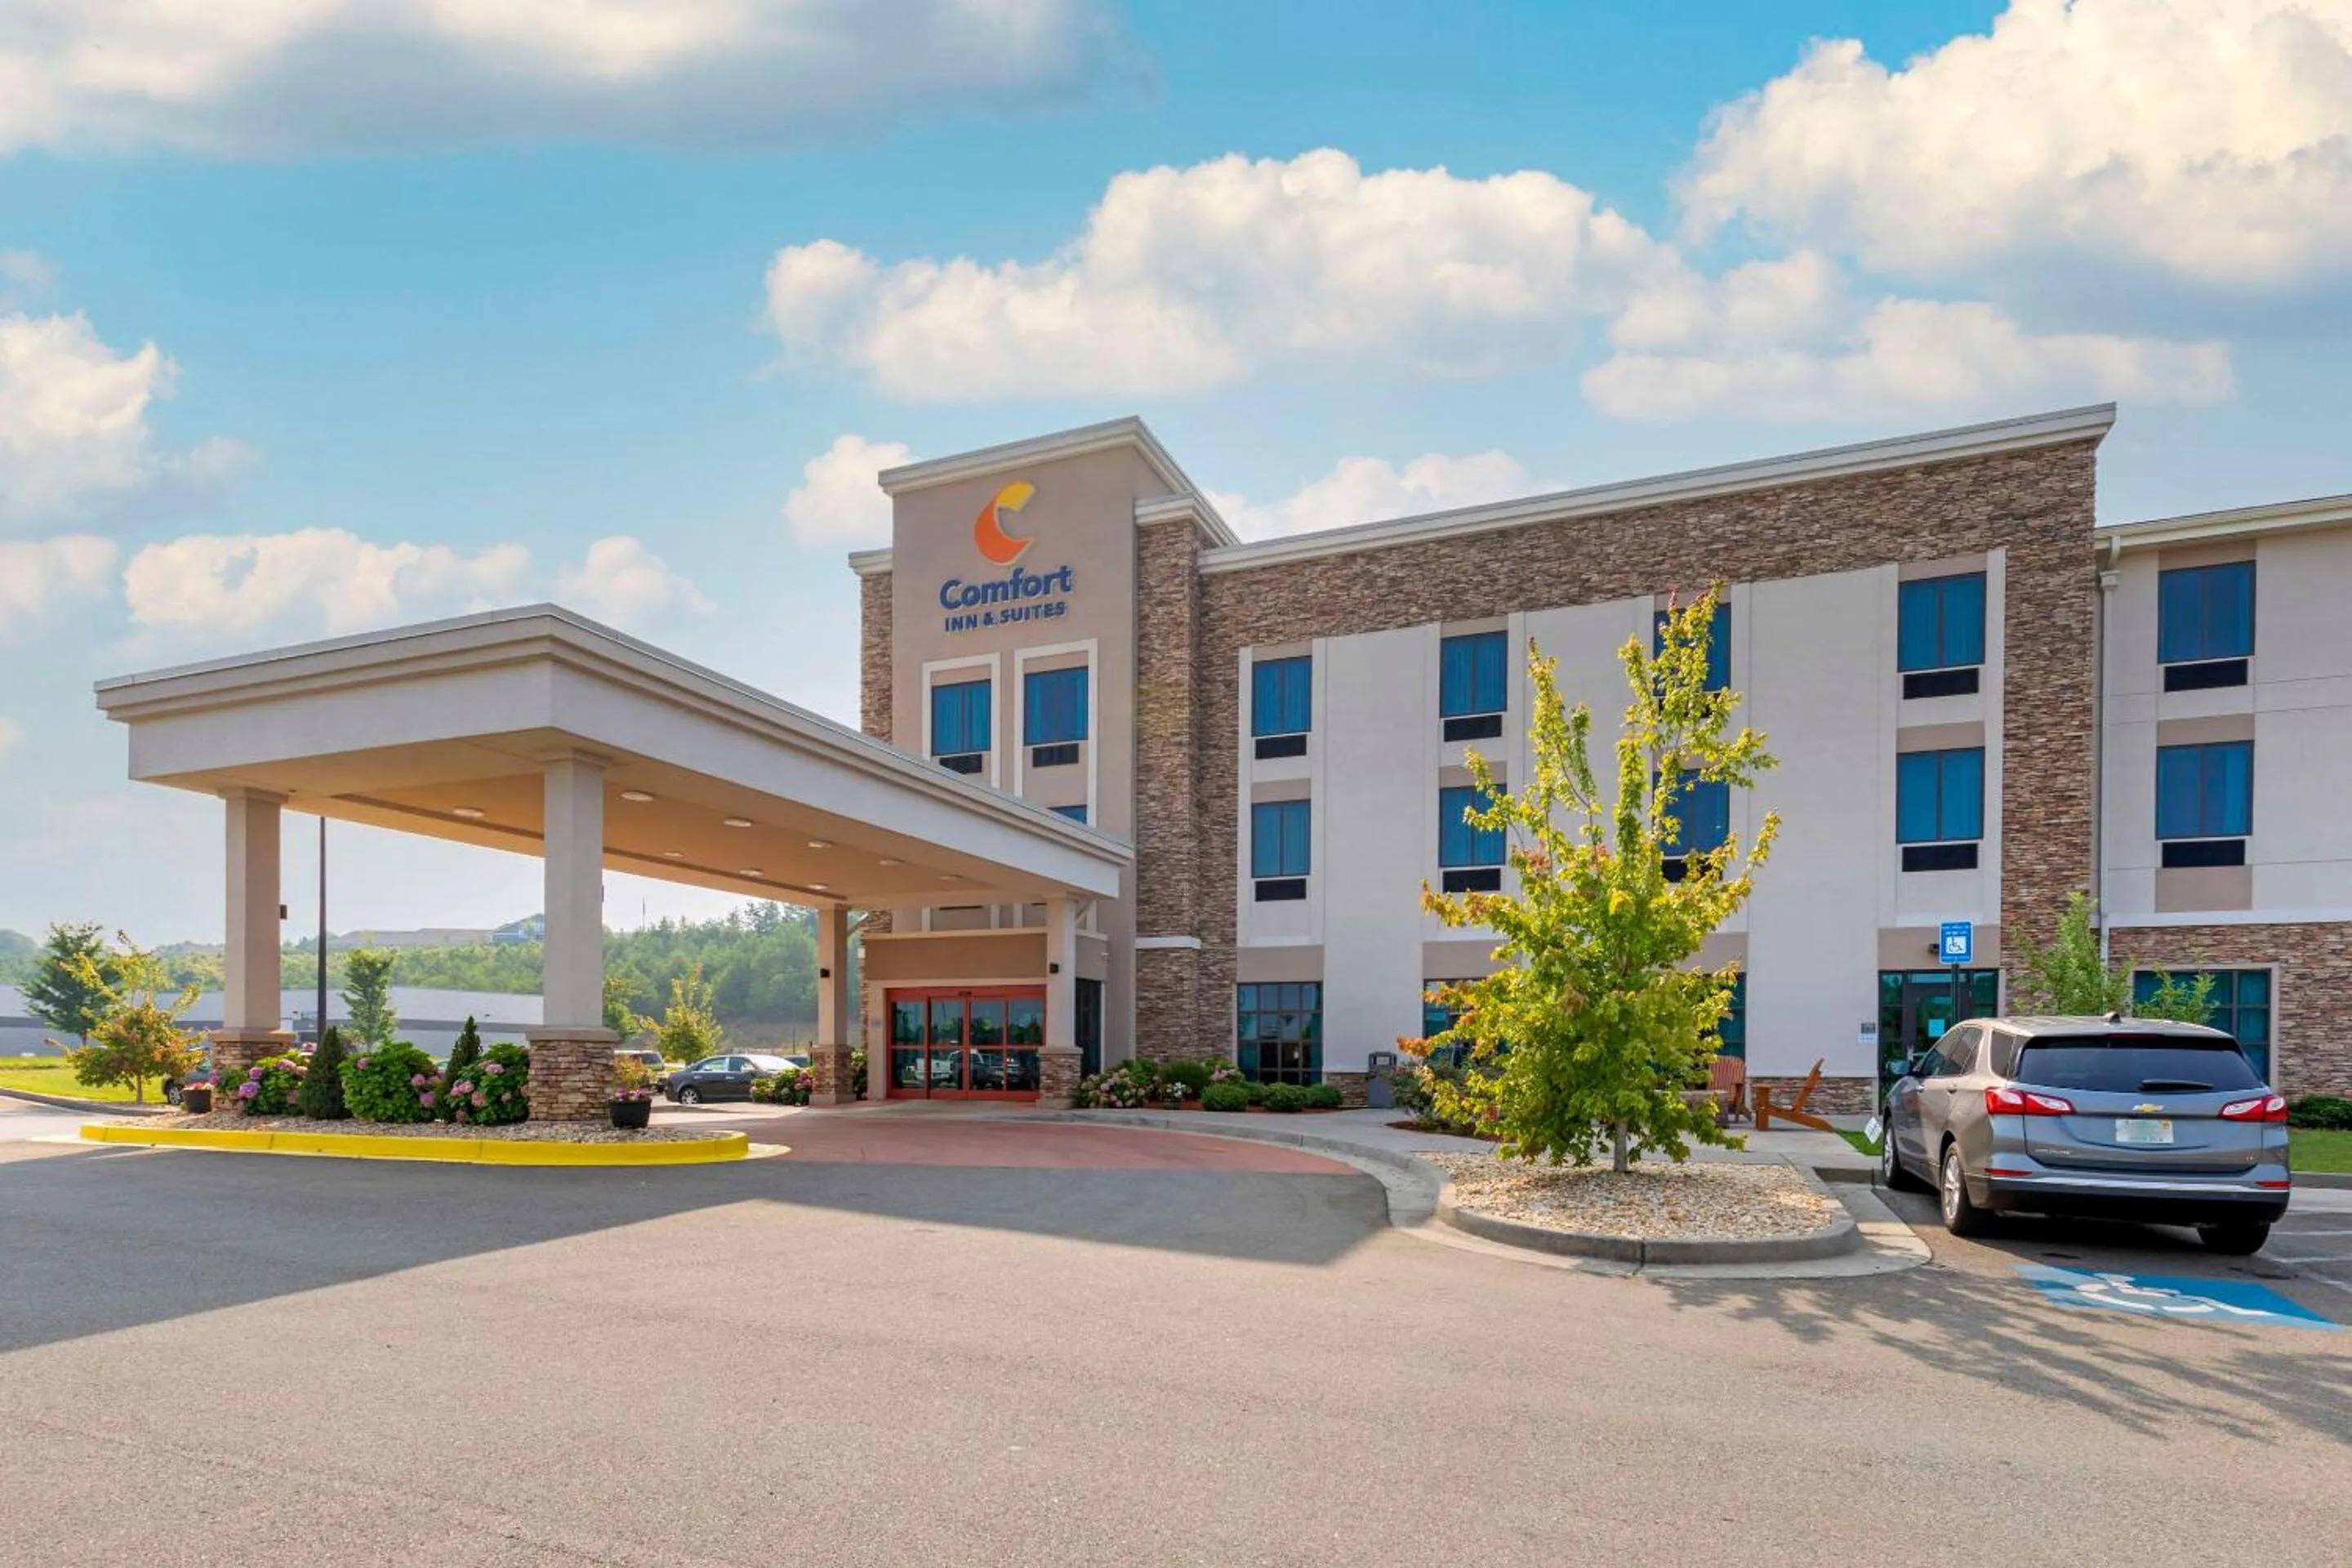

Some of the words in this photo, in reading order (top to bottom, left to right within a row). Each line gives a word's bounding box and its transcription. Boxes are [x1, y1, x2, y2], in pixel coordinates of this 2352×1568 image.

[940, 565, 1072, 610] Comfort
[944, 613, 978, 633] INN
[982, 611, 998, 627] &
[1000, 600, 1067, 624] SUITES
